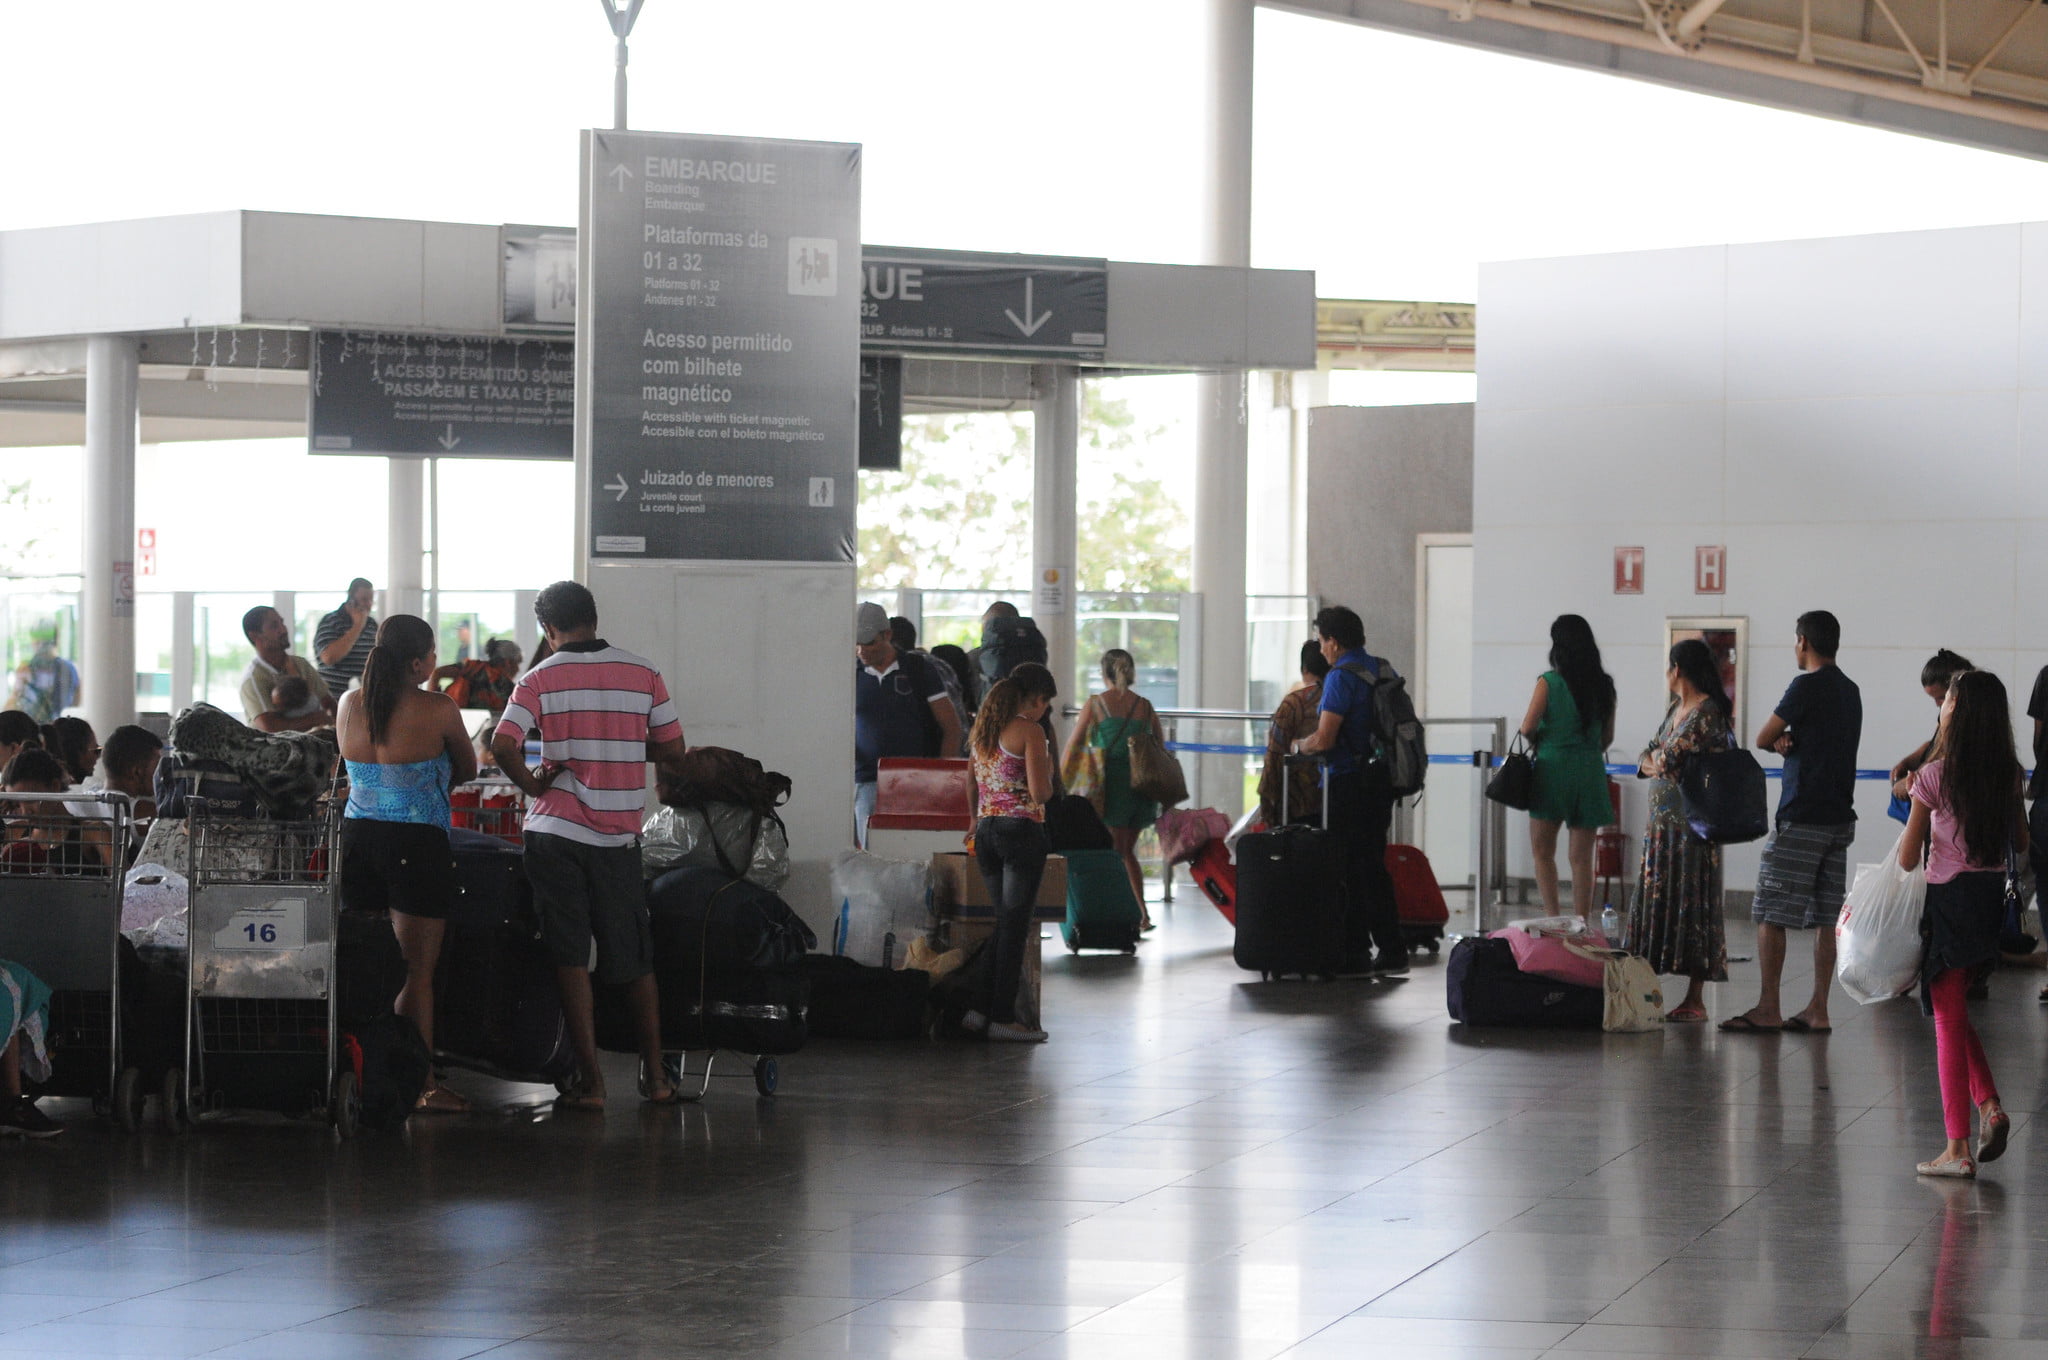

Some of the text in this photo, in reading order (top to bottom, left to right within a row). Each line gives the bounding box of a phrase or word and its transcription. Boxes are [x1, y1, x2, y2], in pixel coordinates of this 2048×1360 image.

[644, 156, 777, 184] EMBARQUE
[645, 181, 700, 198] Boarding
[644, 197, 706, 213] Embarque
[643, 224, 769, 248] Plataformas da
[643, 253, 702, 271] 01 a 32
[644, 278, 689, 291] Platforms
[690, 279, 701, 290] 01
[709, 280, 720, 291] 32
[644, 294, 684, 306] Andenes
[686, 295, 697, 306] 01
[705, 295, 716, 307] 32
[642, 328, 792, 354] Acesso permitido
[384, 363, 446, 379] ACESSO
[448, 366, 528, 383] PERMITIDO
[642, 357, 743, 377] com bilhete
[384, 382, 465, 398] PASSAGEM
[469, 385, 479, 398] E
[482, 386, 519, 400] TAXA
[523, 387, 544, 401] DE
[642, 383, 732, 406] magnético
[642, 411, 811, 428] Accessible with ticket magnetic
[641, 426, 825, 443] Accesible con el boleto magnético
[640, 469, 774, 487] Juizado de menores
[640, 492, 703, 502] Juvenile court
[640, 503, 706, 515] La corte juvenil
[1700, 551, 1720, 588] H
[243, 923, 277, 943] 16
